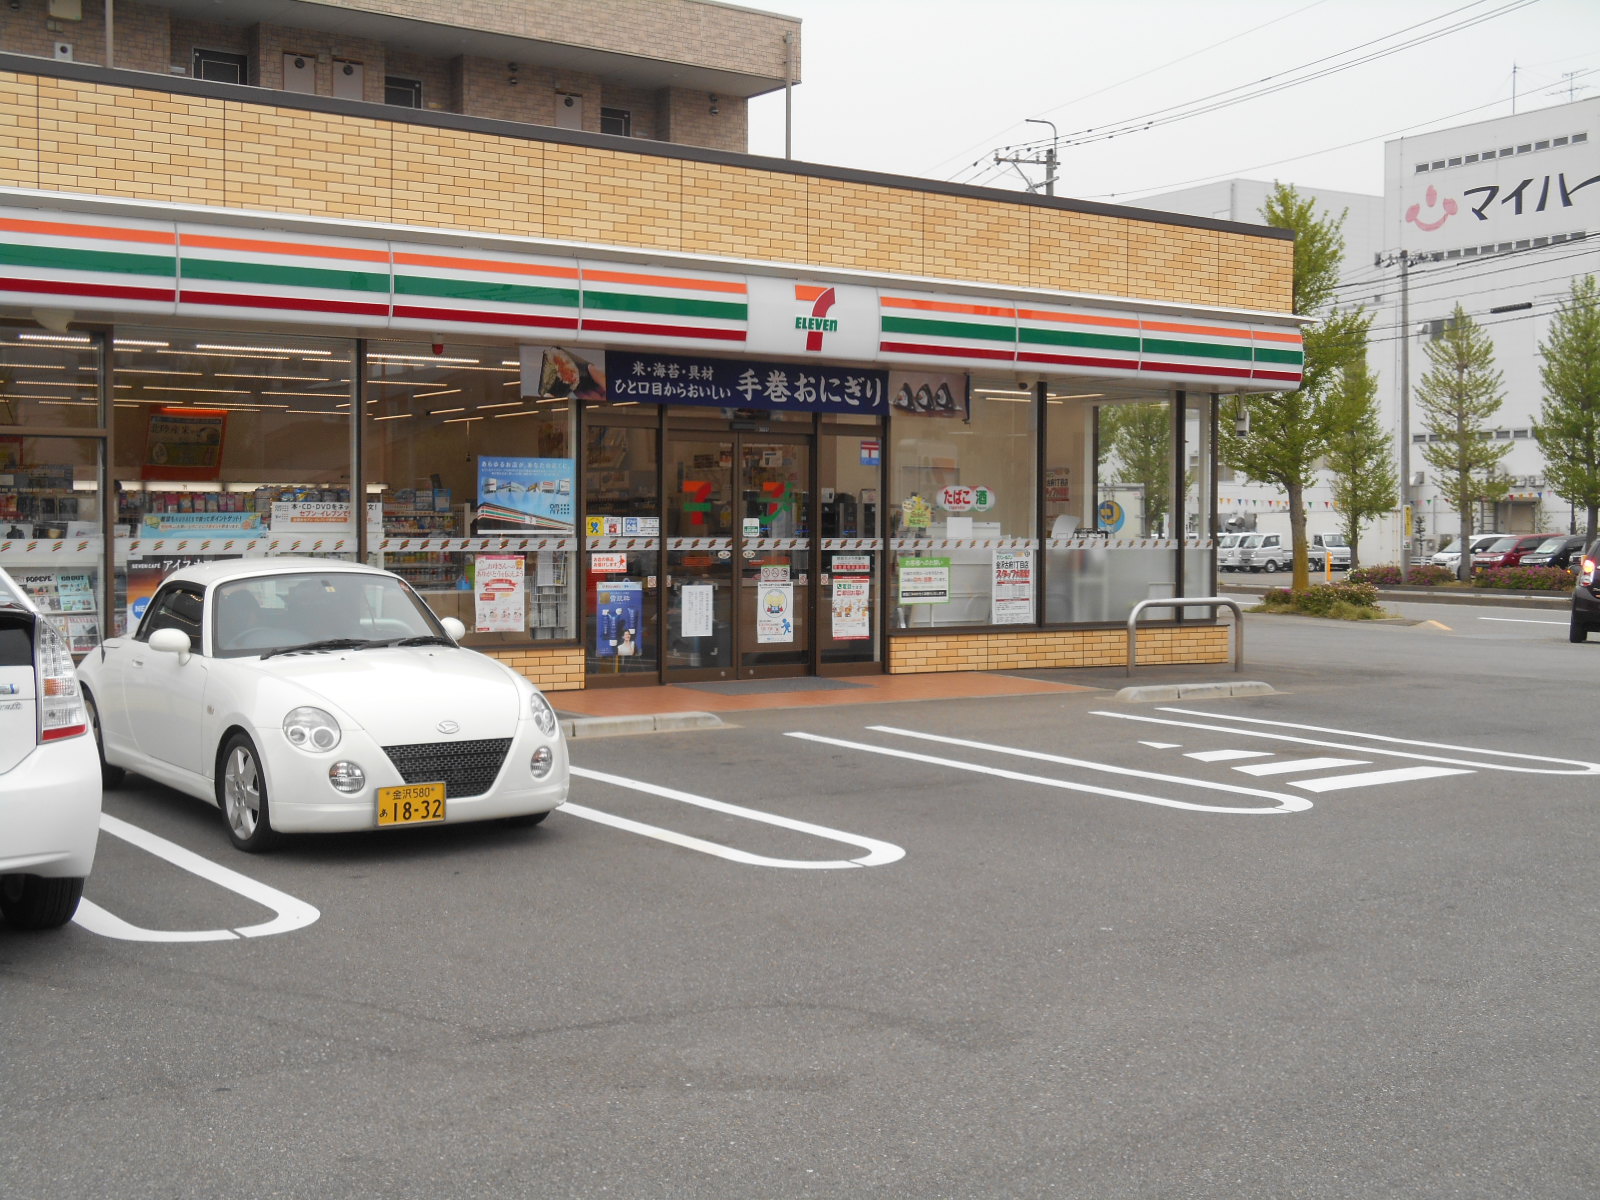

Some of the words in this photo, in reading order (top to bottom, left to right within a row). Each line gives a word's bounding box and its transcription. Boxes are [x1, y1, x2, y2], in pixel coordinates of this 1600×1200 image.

[794, 316, 838, 332] ELEVEN
[614, 378, 731, 400] ひと口目からおいしい
[735, 368, 884, 408] 手巻おにぎり
[943, 489, 971, 505] たばこ
[975, 489, 988, 505] 酒
[392, 787, 430, 800] 金沢580
[393, 799, 442, 822] 18-32
